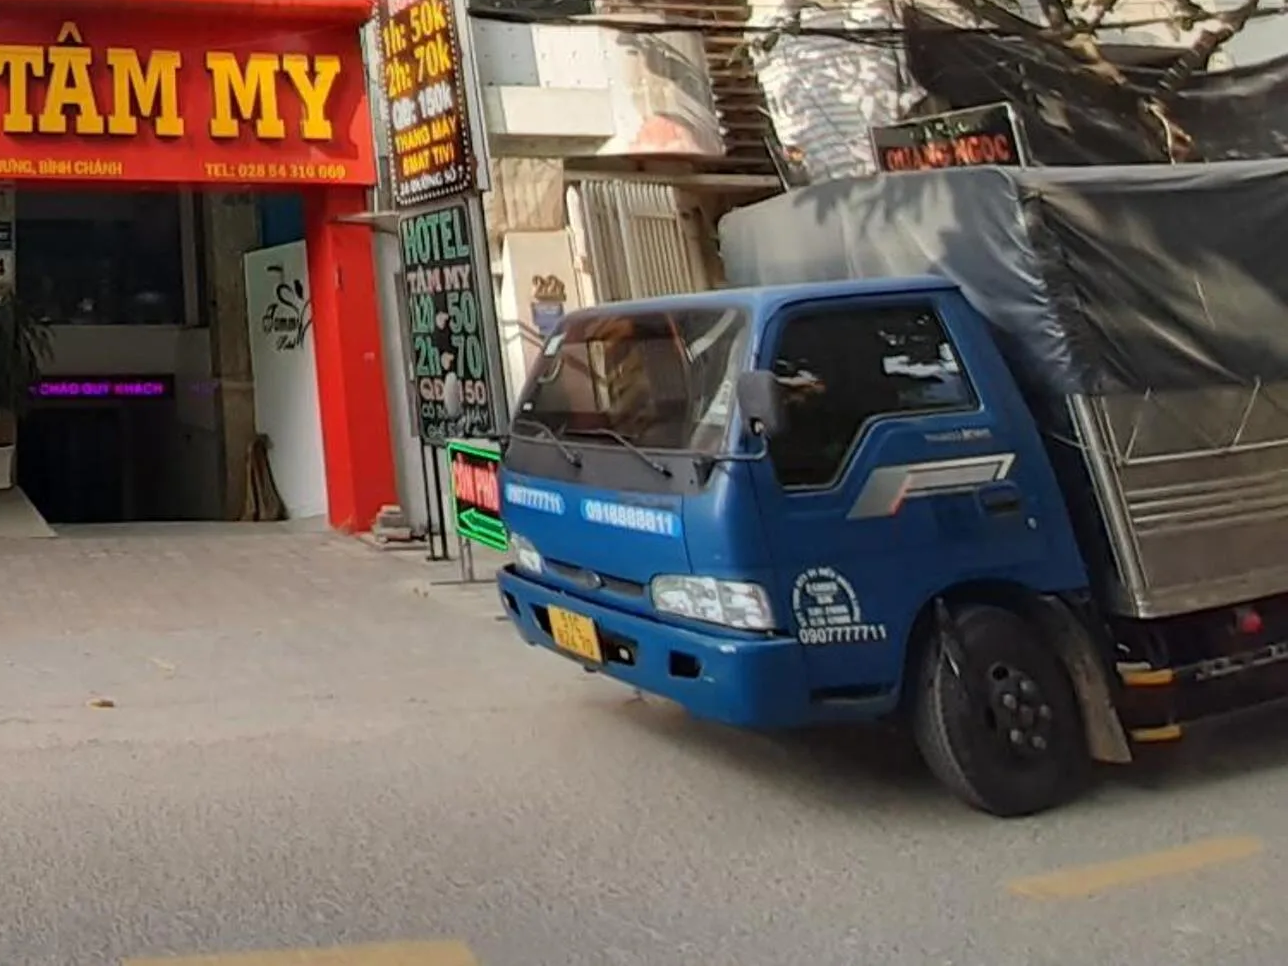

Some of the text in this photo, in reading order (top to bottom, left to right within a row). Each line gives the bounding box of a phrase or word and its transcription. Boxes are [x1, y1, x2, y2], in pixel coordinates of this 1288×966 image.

[414, 32, 451, 82] 70k
[206, 52, 341, 140] MY
[402, 208, 470, 265] HOTEL
[443, 263, 470, 290] MY
[447, 291, 476, 334] 50
[415, 334, 484, 379] 2h 70
